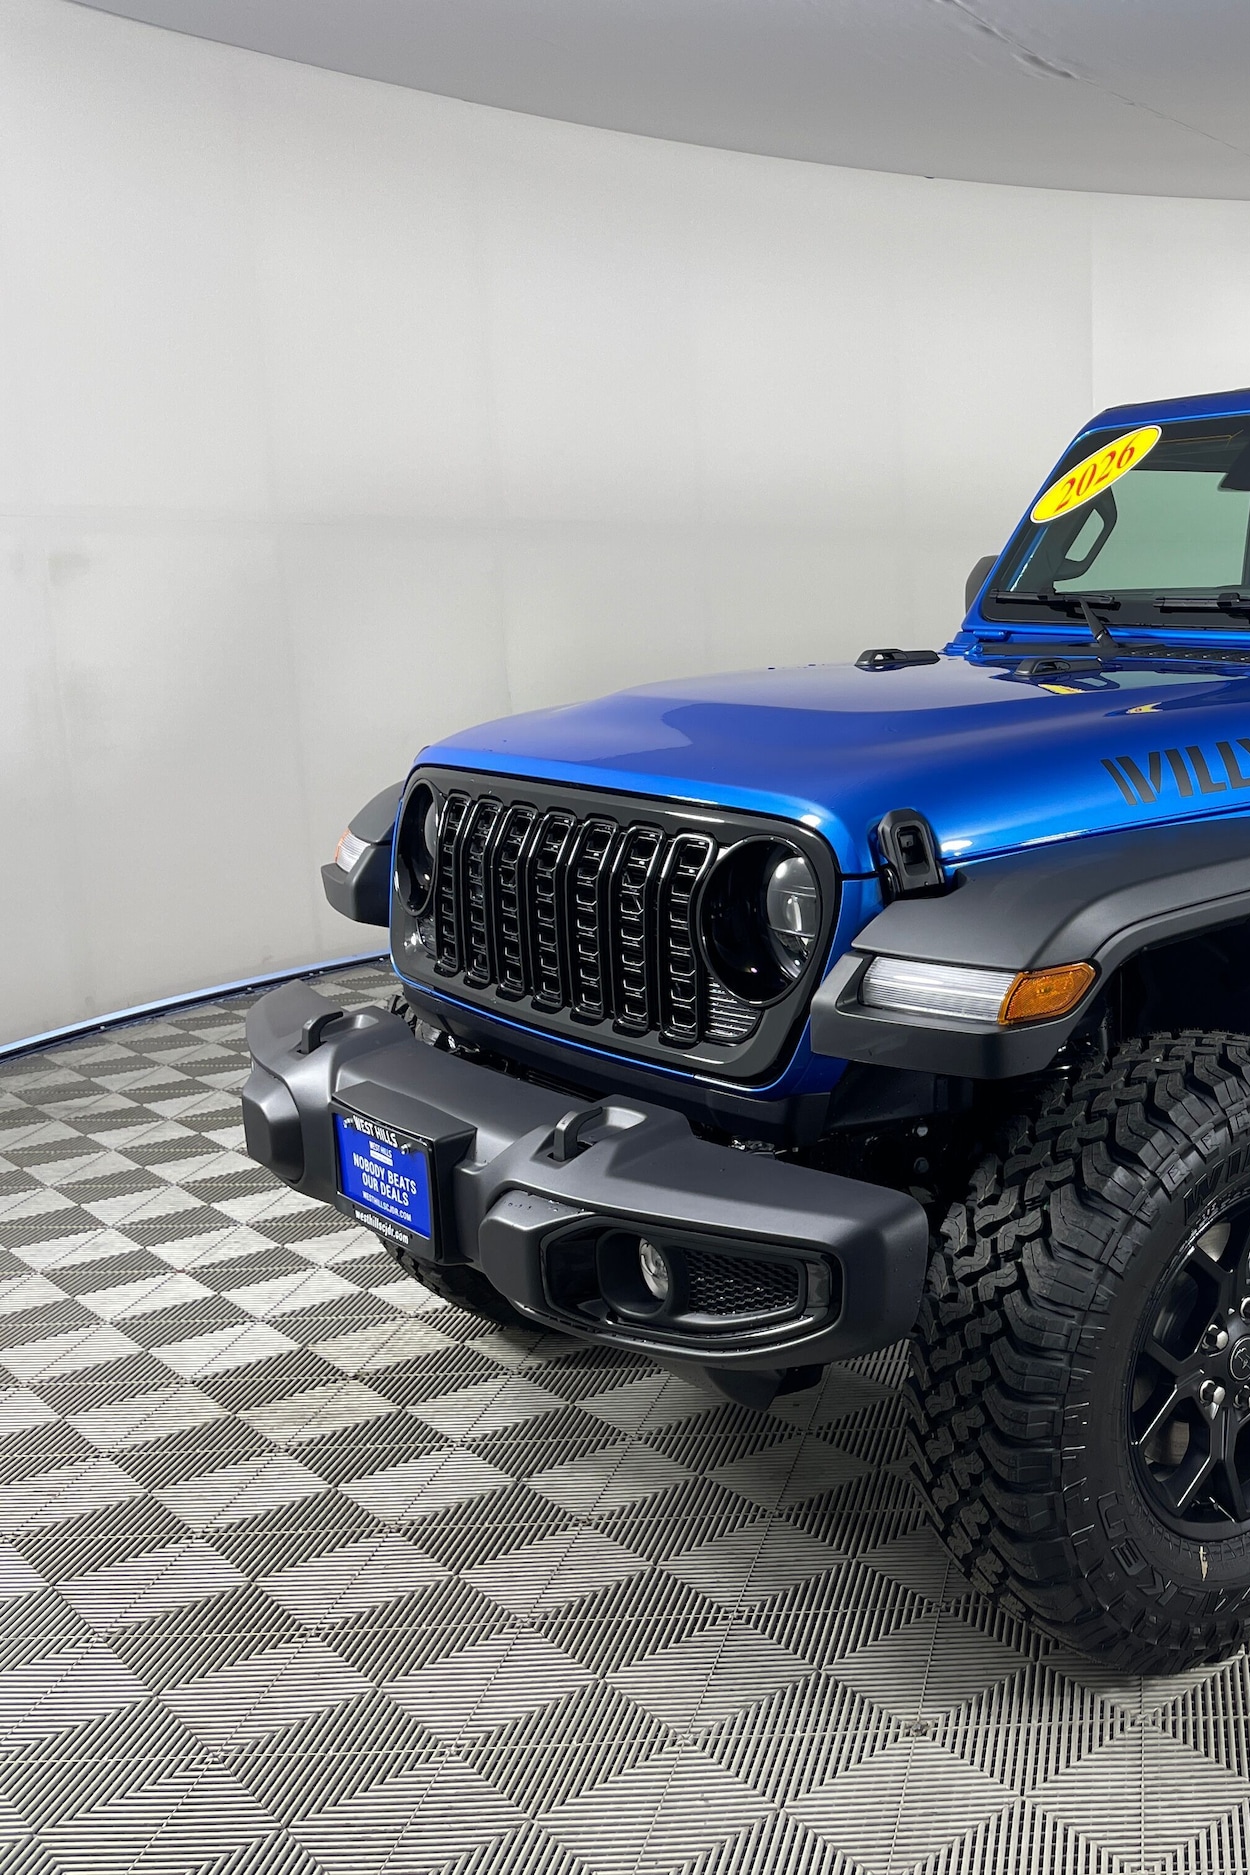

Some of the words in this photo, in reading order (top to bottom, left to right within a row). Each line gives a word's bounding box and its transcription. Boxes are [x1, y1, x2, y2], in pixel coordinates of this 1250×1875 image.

[1053, 432, 1140, 514] 2026
[353, 1114, 375, 1137] WEST
[374, 1125, 398, 1149] HILLS
[352, 1152, 386, 1181] NOBODY
[387, 1169, 417, 1195] BEATS
[362, 1171, 379, 1193] OUR
[380, 1181, 410, 1207] DEALS
[354, 1209, 409, 1245] westhillscjdr.com
